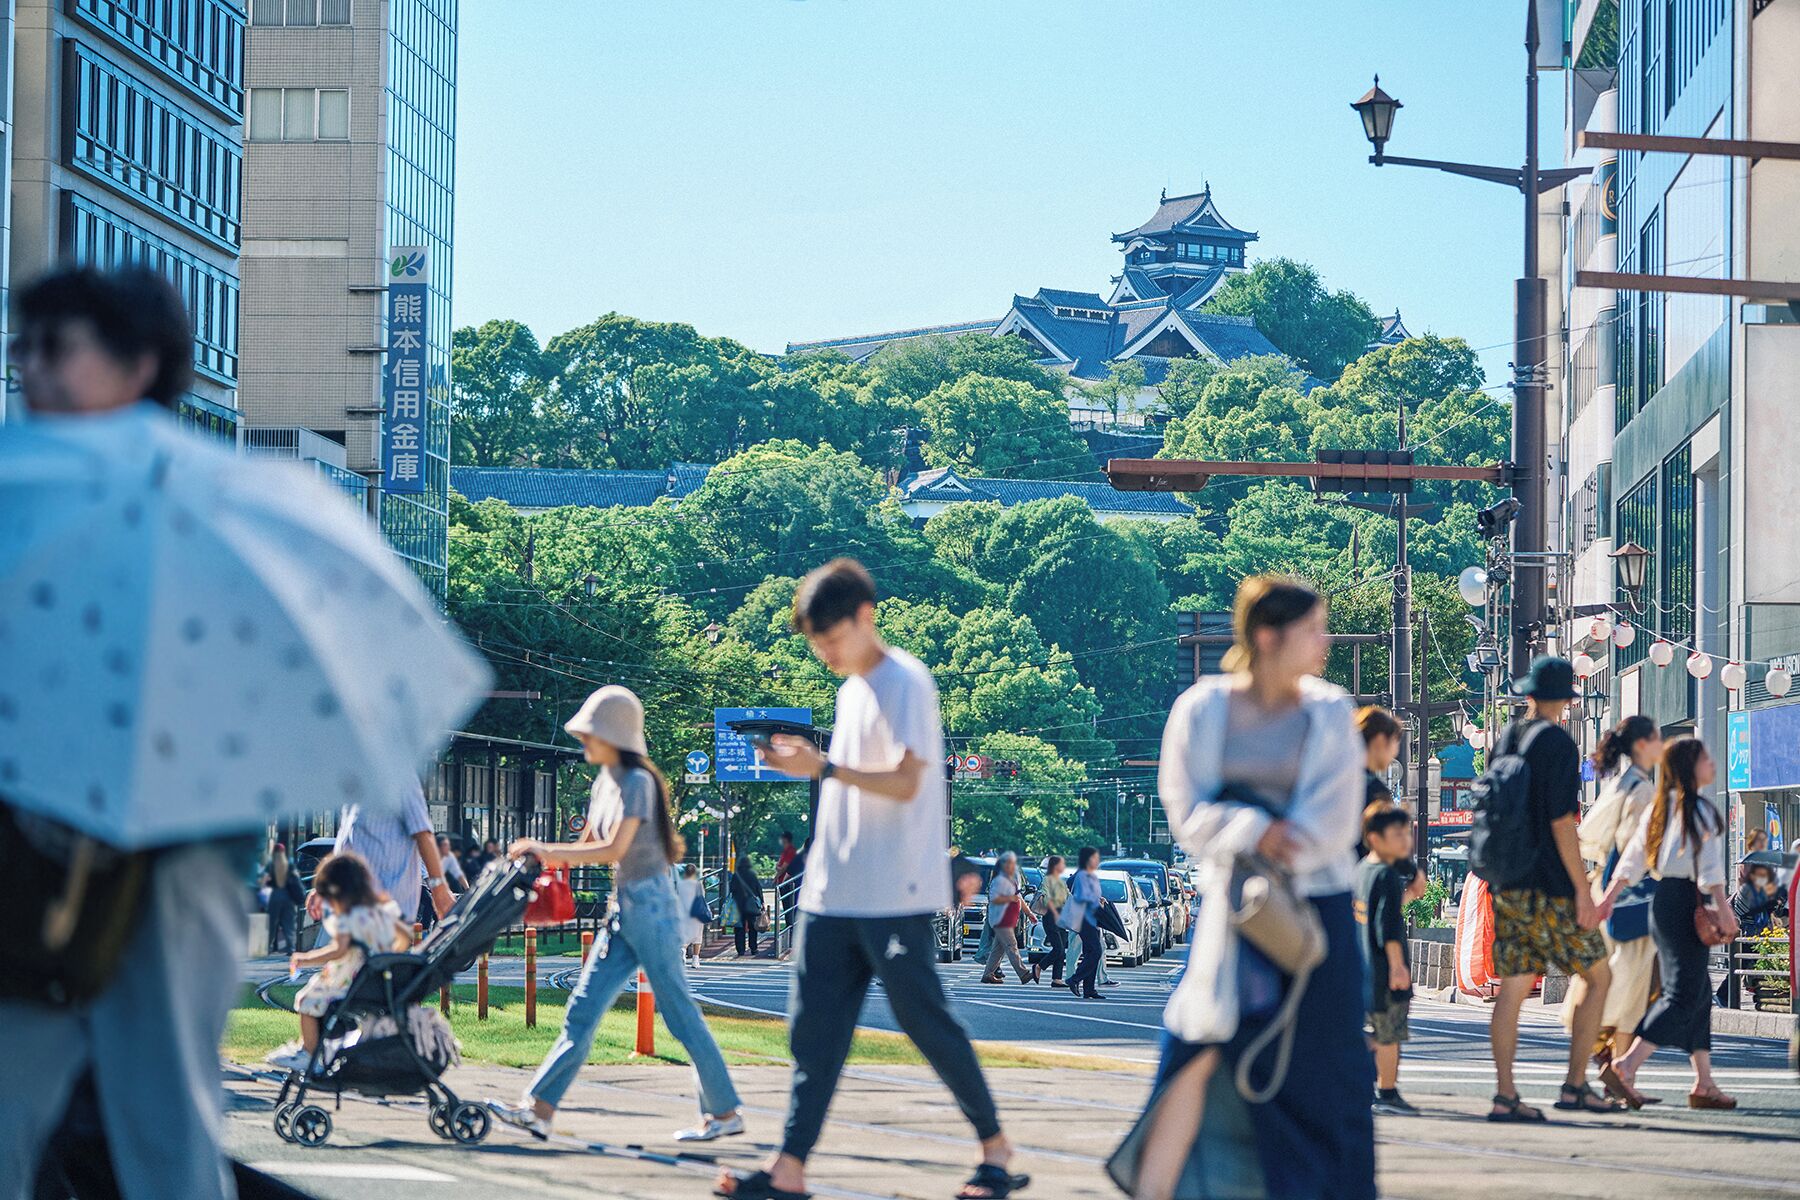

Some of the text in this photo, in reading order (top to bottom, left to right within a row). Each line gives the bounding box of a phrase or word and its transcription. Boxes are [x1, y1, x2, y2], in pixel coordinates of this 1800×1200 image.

[391, 294, 422, 482] 熊本信用金庫
[718, 748, 746, 757] 熊本城
